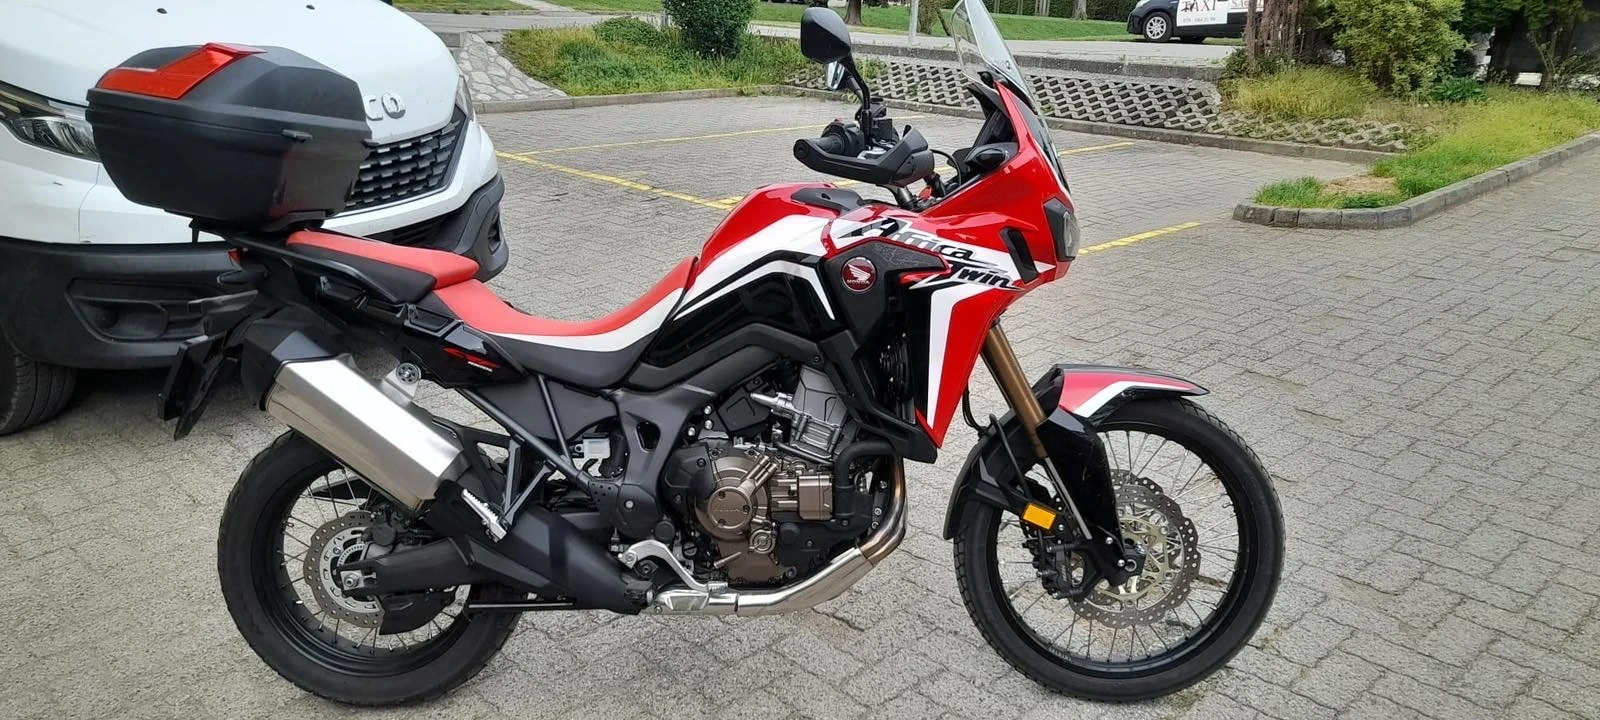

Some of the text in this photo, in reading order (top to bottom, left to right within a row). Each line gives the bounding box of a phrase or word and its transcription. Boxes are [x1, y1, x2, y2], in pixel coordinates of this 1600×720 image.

[1181, 0, 1216, 12] TAXI
[838, 218, 992, 265] Africa
[924, 260, 1021, 290] Twin
